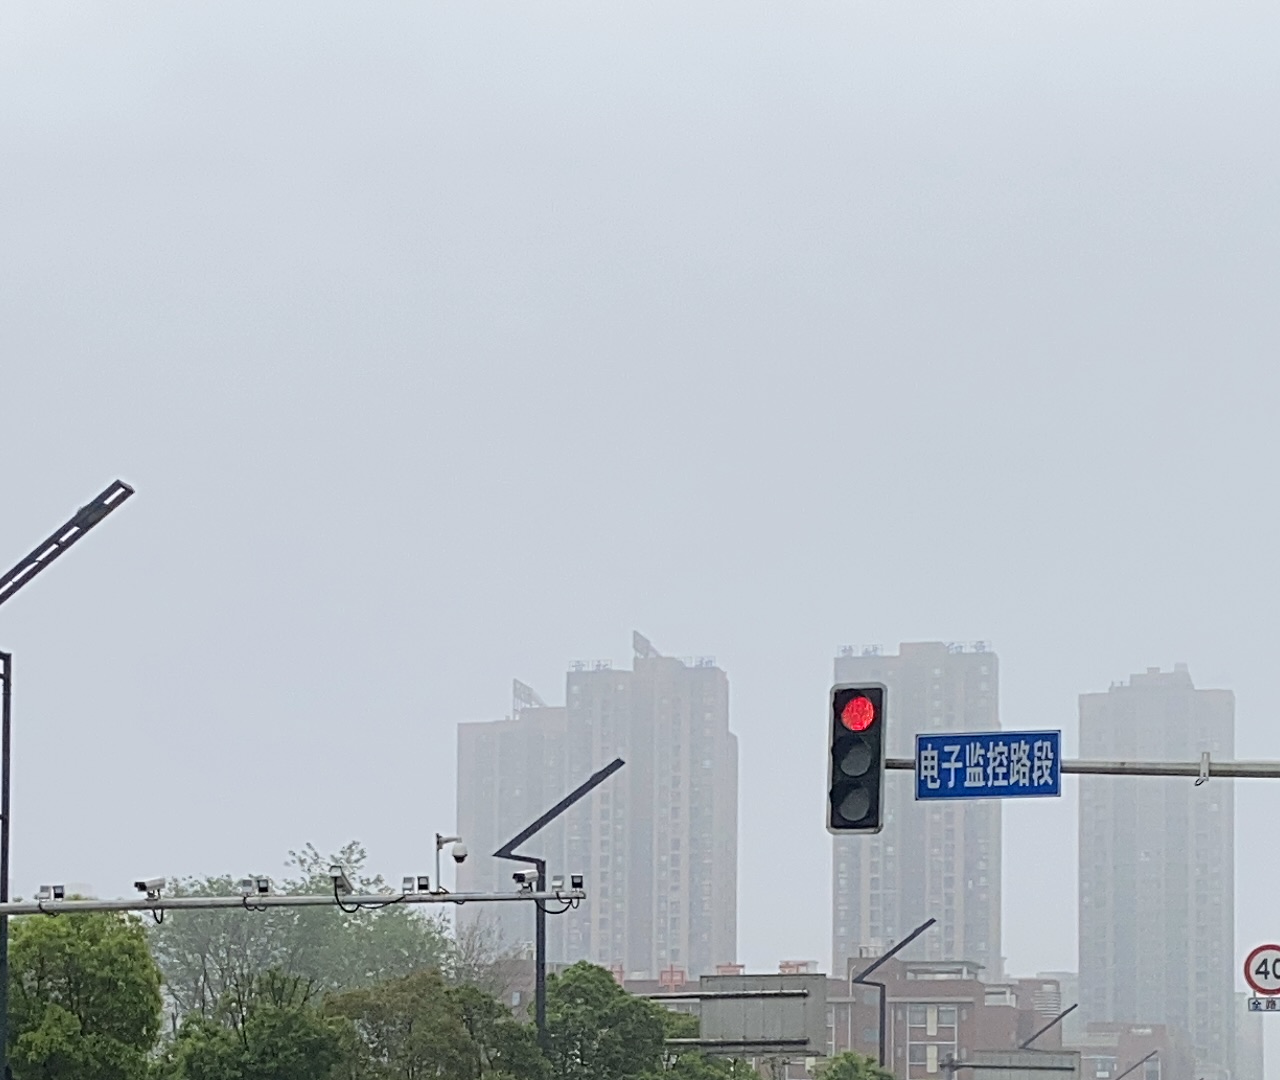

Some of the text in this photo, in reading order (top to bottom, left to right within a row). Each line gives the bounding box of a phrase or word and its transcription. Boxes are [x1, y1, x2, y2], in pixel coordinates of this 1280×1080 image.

[921, 740, 1053, 789] 电子监控路段
